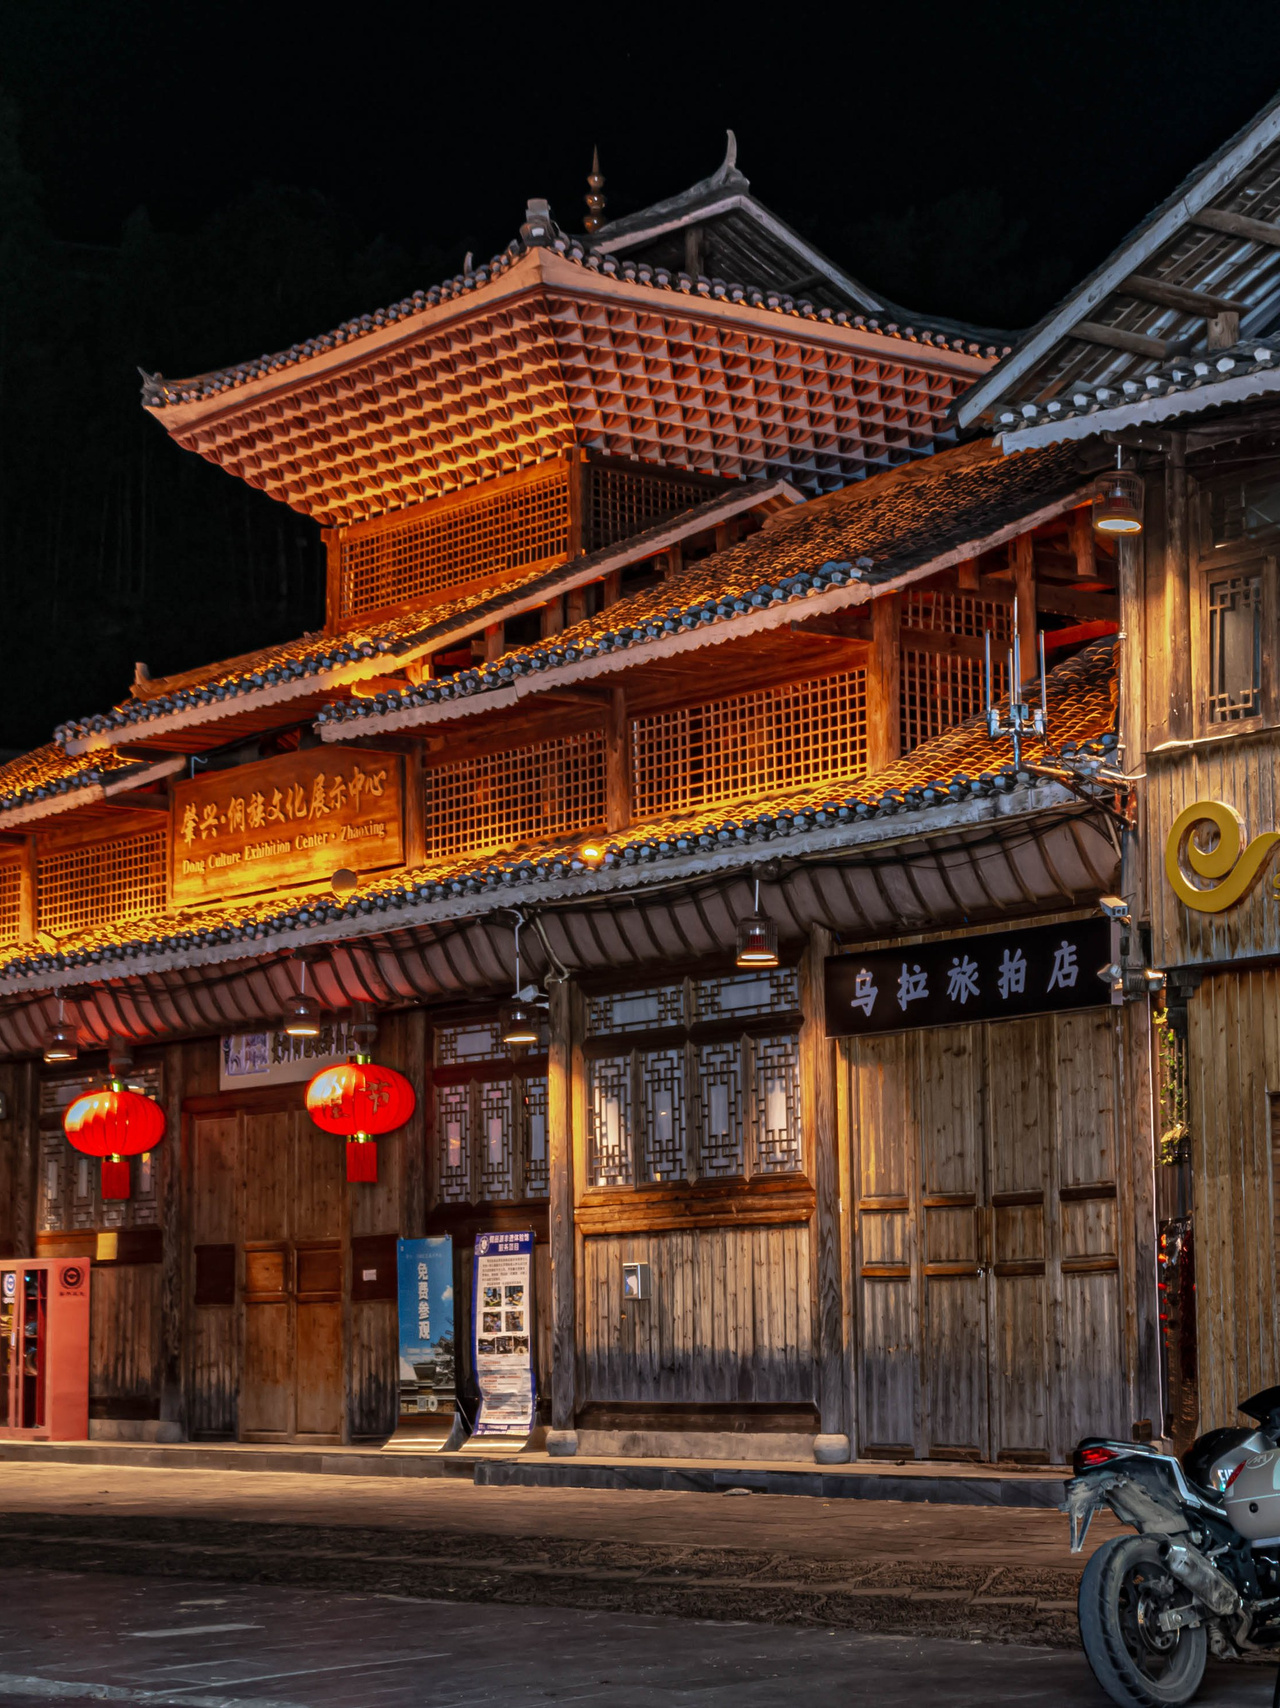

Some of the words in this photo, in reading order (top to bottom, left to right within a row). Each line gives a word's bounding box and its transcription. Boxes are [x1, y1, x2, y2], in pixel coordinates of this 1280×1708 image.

[182, 858, 205, 875] Dong
[208, 850, 241, 869] Culture
[244, 838, 291, 861] Exhibition
[295, 832, 329, 851] Center
[340, 820, 385, 842] Zhaoxing
[851, 940, 1079, 1017] 乌拉旅拍店
[417, 1262, 431, 1340] 免费参观
